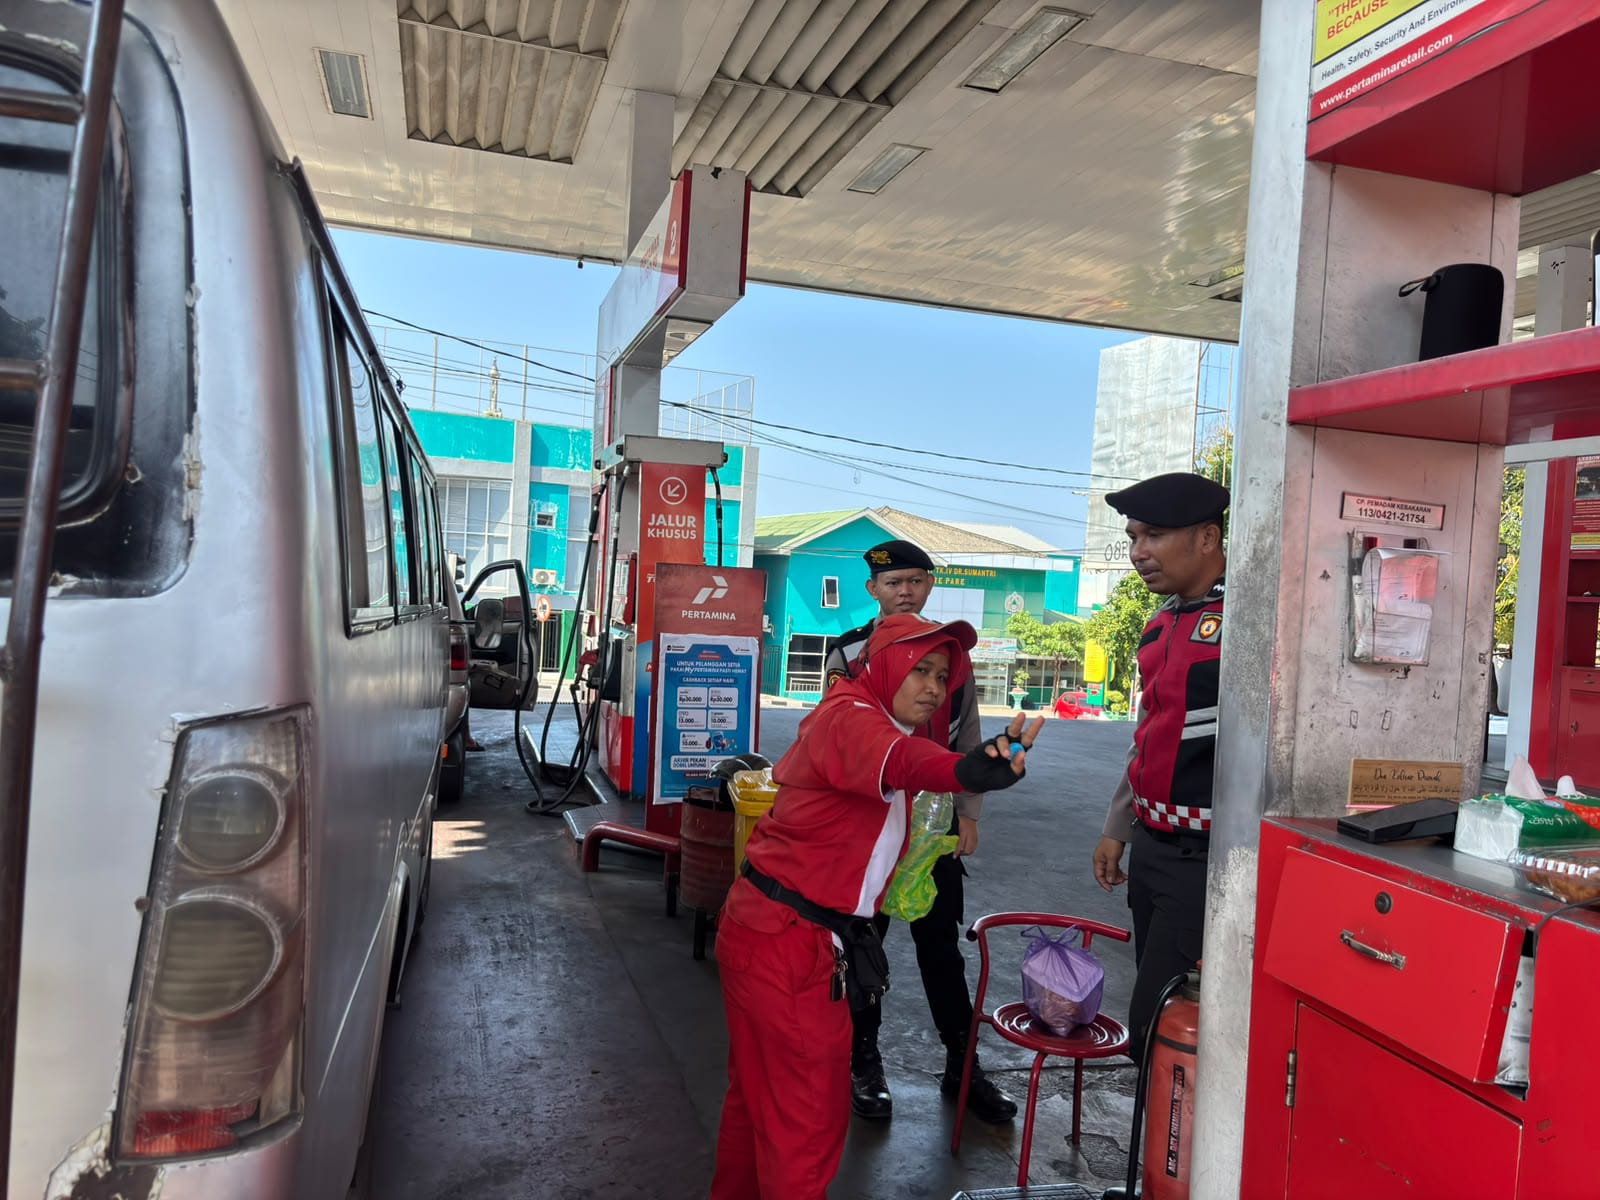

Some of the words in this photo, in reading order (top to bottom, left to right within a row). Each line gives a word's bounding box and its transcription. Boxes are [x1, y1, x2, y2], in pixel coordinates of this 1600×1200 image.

[1327, 0, 1388, 39] BECAUSE
[1347, 47, 1373, 66] Safety,
[1374, 27, 1407, 50] Security
[1408, 15, 1426, 32] And
[1319, 33, 1453, 110] www.pertaminaretail.com
[1367, 499, 1396, 508] PEMADAM
[1397, 503, 1432, 513] KEBAKARAN
[648, 513, 697, 528] JALUR
[1358, 507, 1426, 523] 113/0421-21754
[647, 528, 697, 540] KHUSUS
[681, 609, 736, 621] PERTAMINA
[1171, 1102, 1182, 1136] CHEMICAL
[1167, 1157, 1176, 1173] ABC
